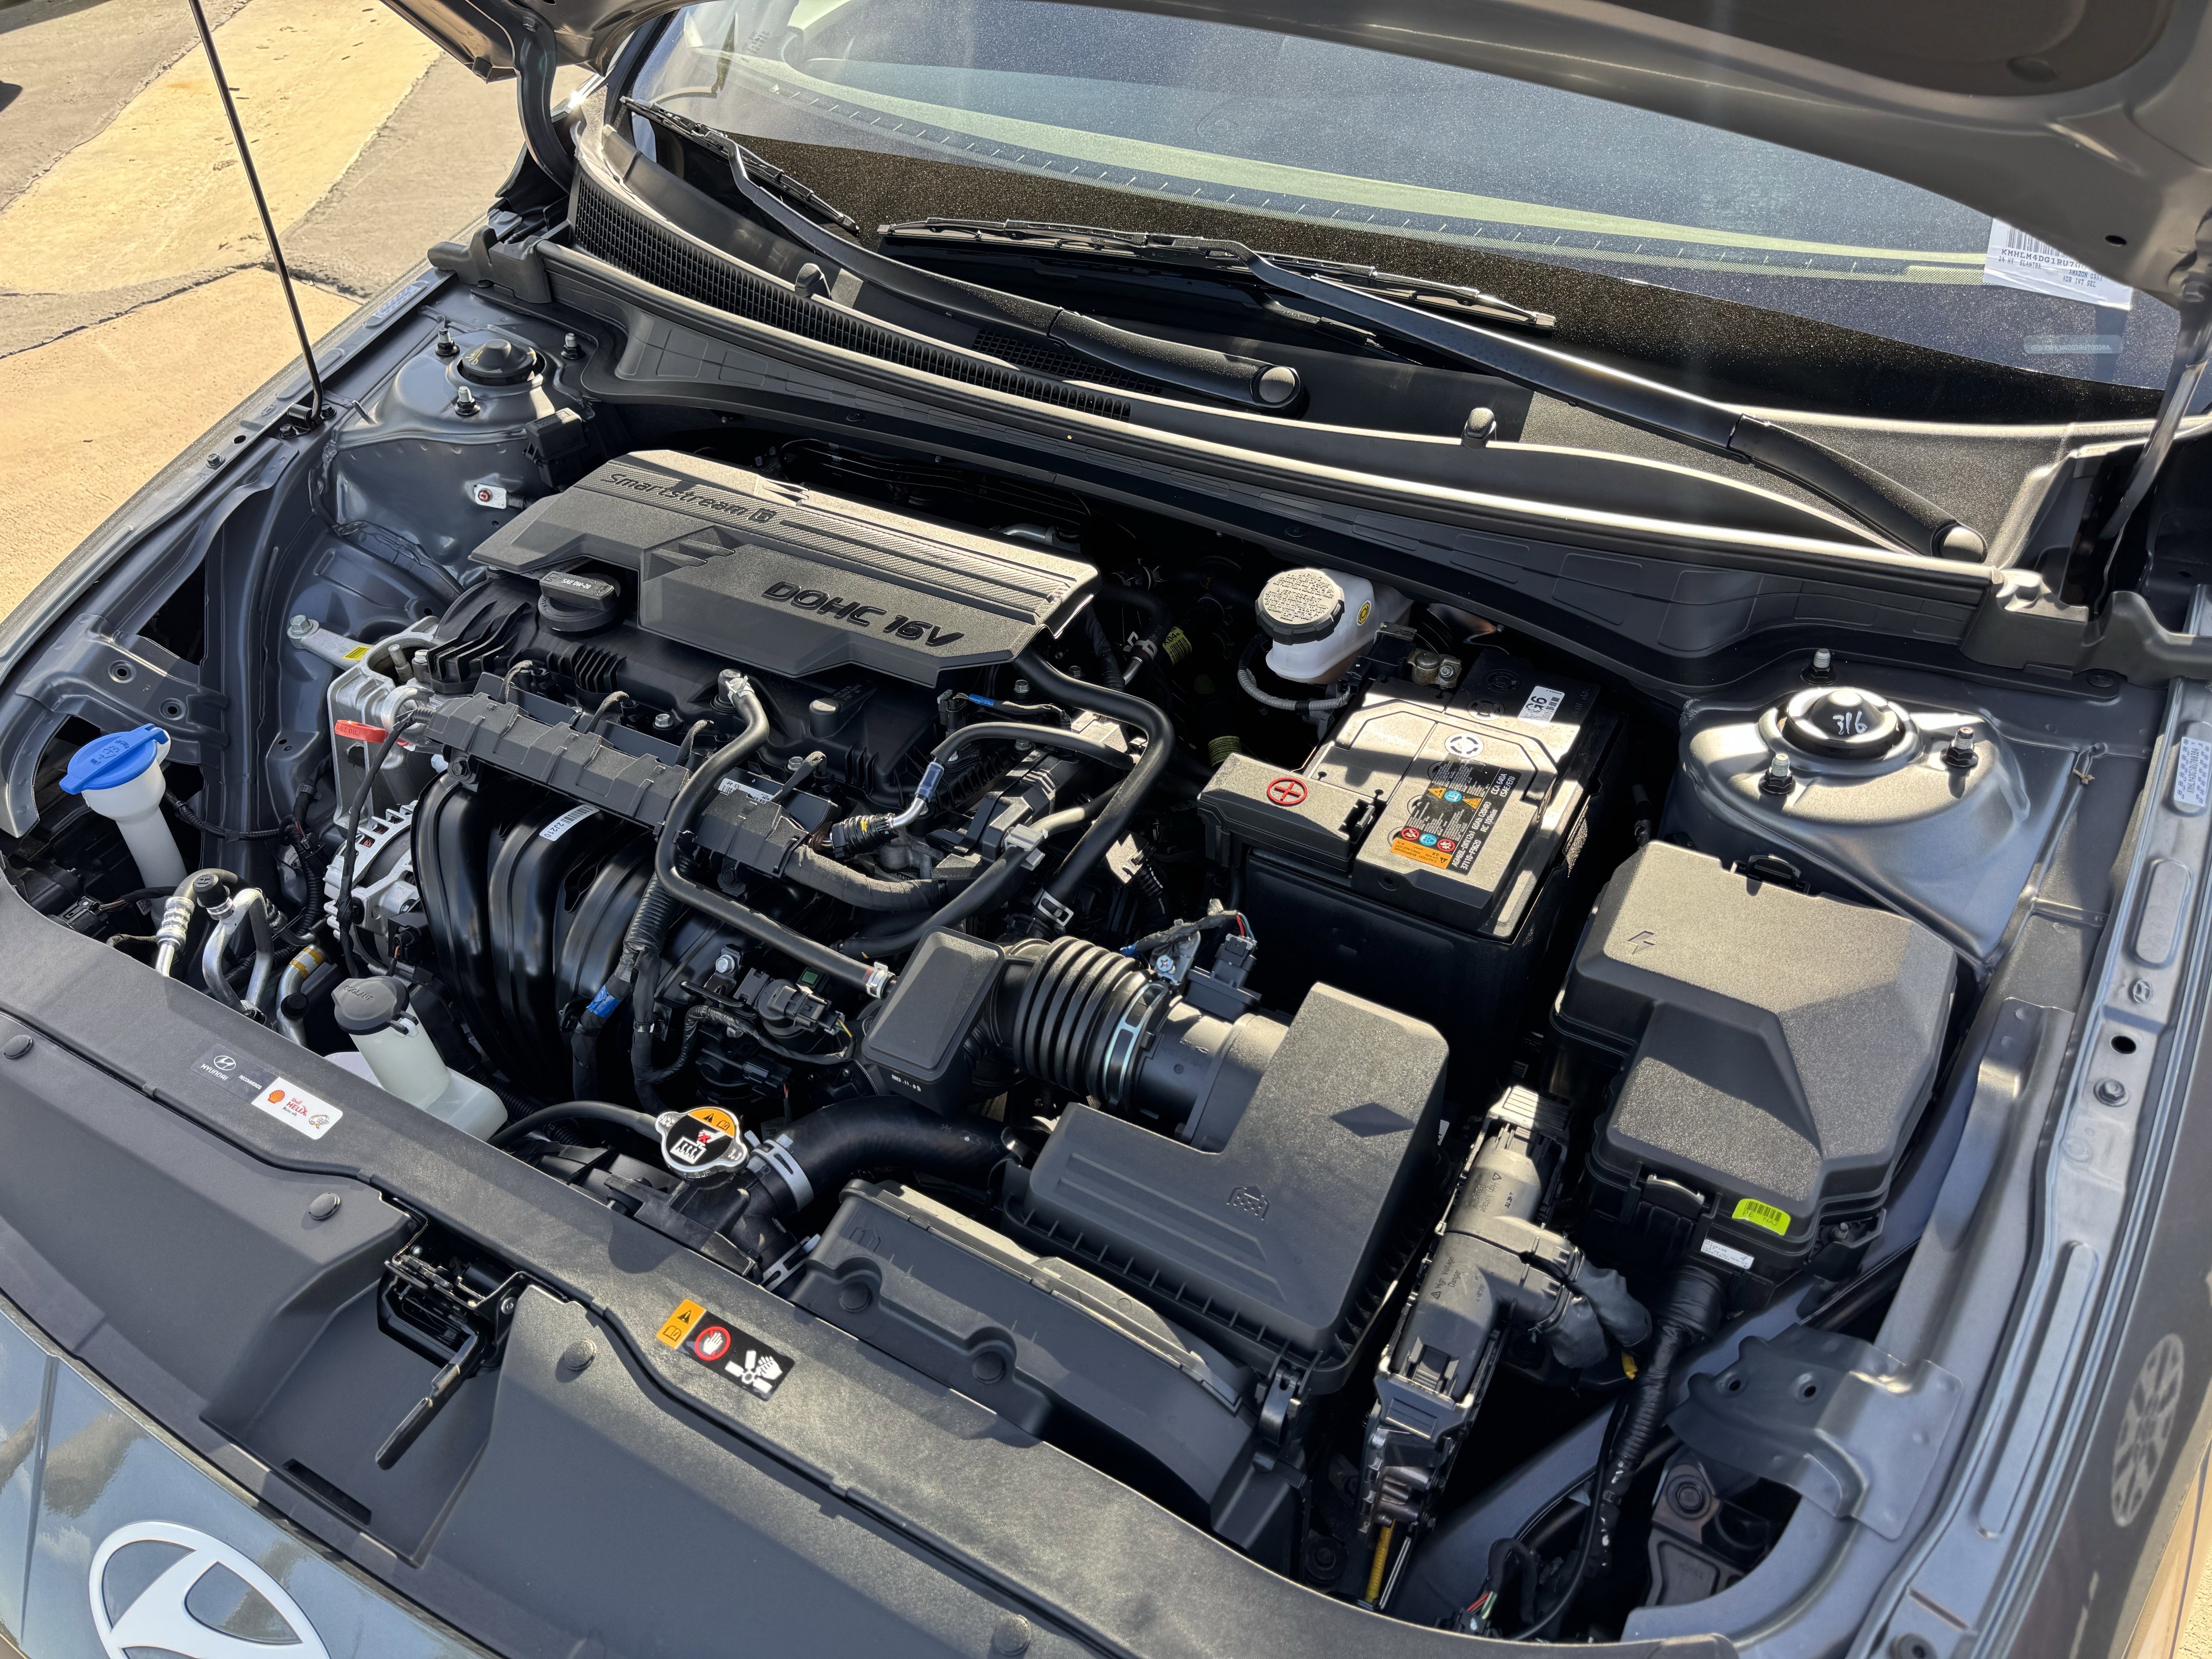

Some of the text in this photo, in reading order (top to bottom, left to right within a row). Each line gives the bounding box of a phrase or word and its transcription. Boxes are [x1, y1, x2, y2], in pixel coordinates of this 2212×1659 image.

[2020, 260, 2042, 269] ELANTRA
[2069, 269, 2088, 278] AMAZON
[601, 473, 748, 516] Smartstream
[574, 580, 592, 589] 0W-20
[761, 581, 965, 647] DOHC 16V
[1491, 785, 1500, 795] CCA
[1497, 774, 1507, 785] 640A
[1484, 809, 1498, 824] 100min
[544, 822, 564, 838] 2J210
[1480, 824, 1489, 832] RC
[344, 986, 373, 1001] COOLANT
[201, 1063, 229, 1081] HYUNDAI
[286, 1101, 308, 1117] HELIX
[1743, 1209, 1753, 1218] PE
[1441, 1256, 1455, 1275] Voltage
[1447, 1269, 1462, 1288] Danger
